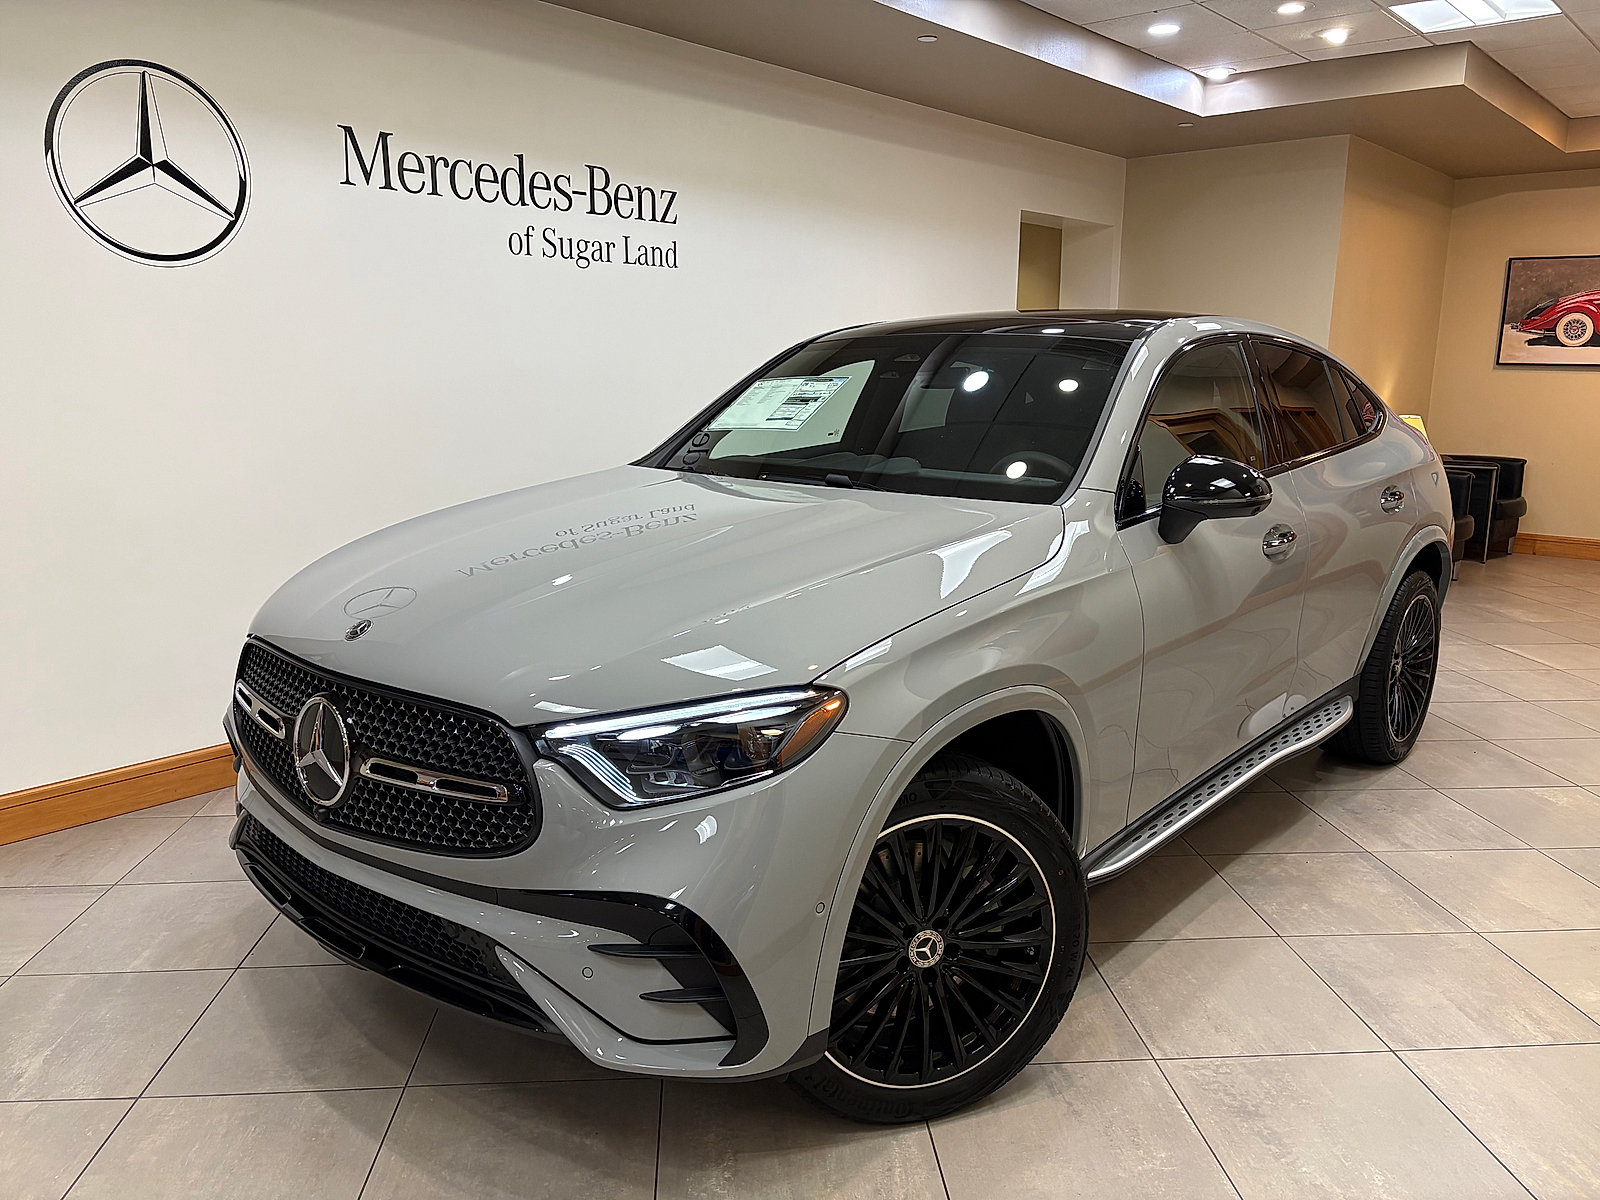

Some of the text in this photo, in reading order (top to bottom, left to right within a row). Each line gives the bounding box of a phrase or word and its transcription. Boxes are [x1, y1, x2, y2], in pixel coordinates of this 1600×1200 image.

[337, 123, 679, 225] Mercedes-Benz
[508, 225, 679, 269] of Sugar Land
